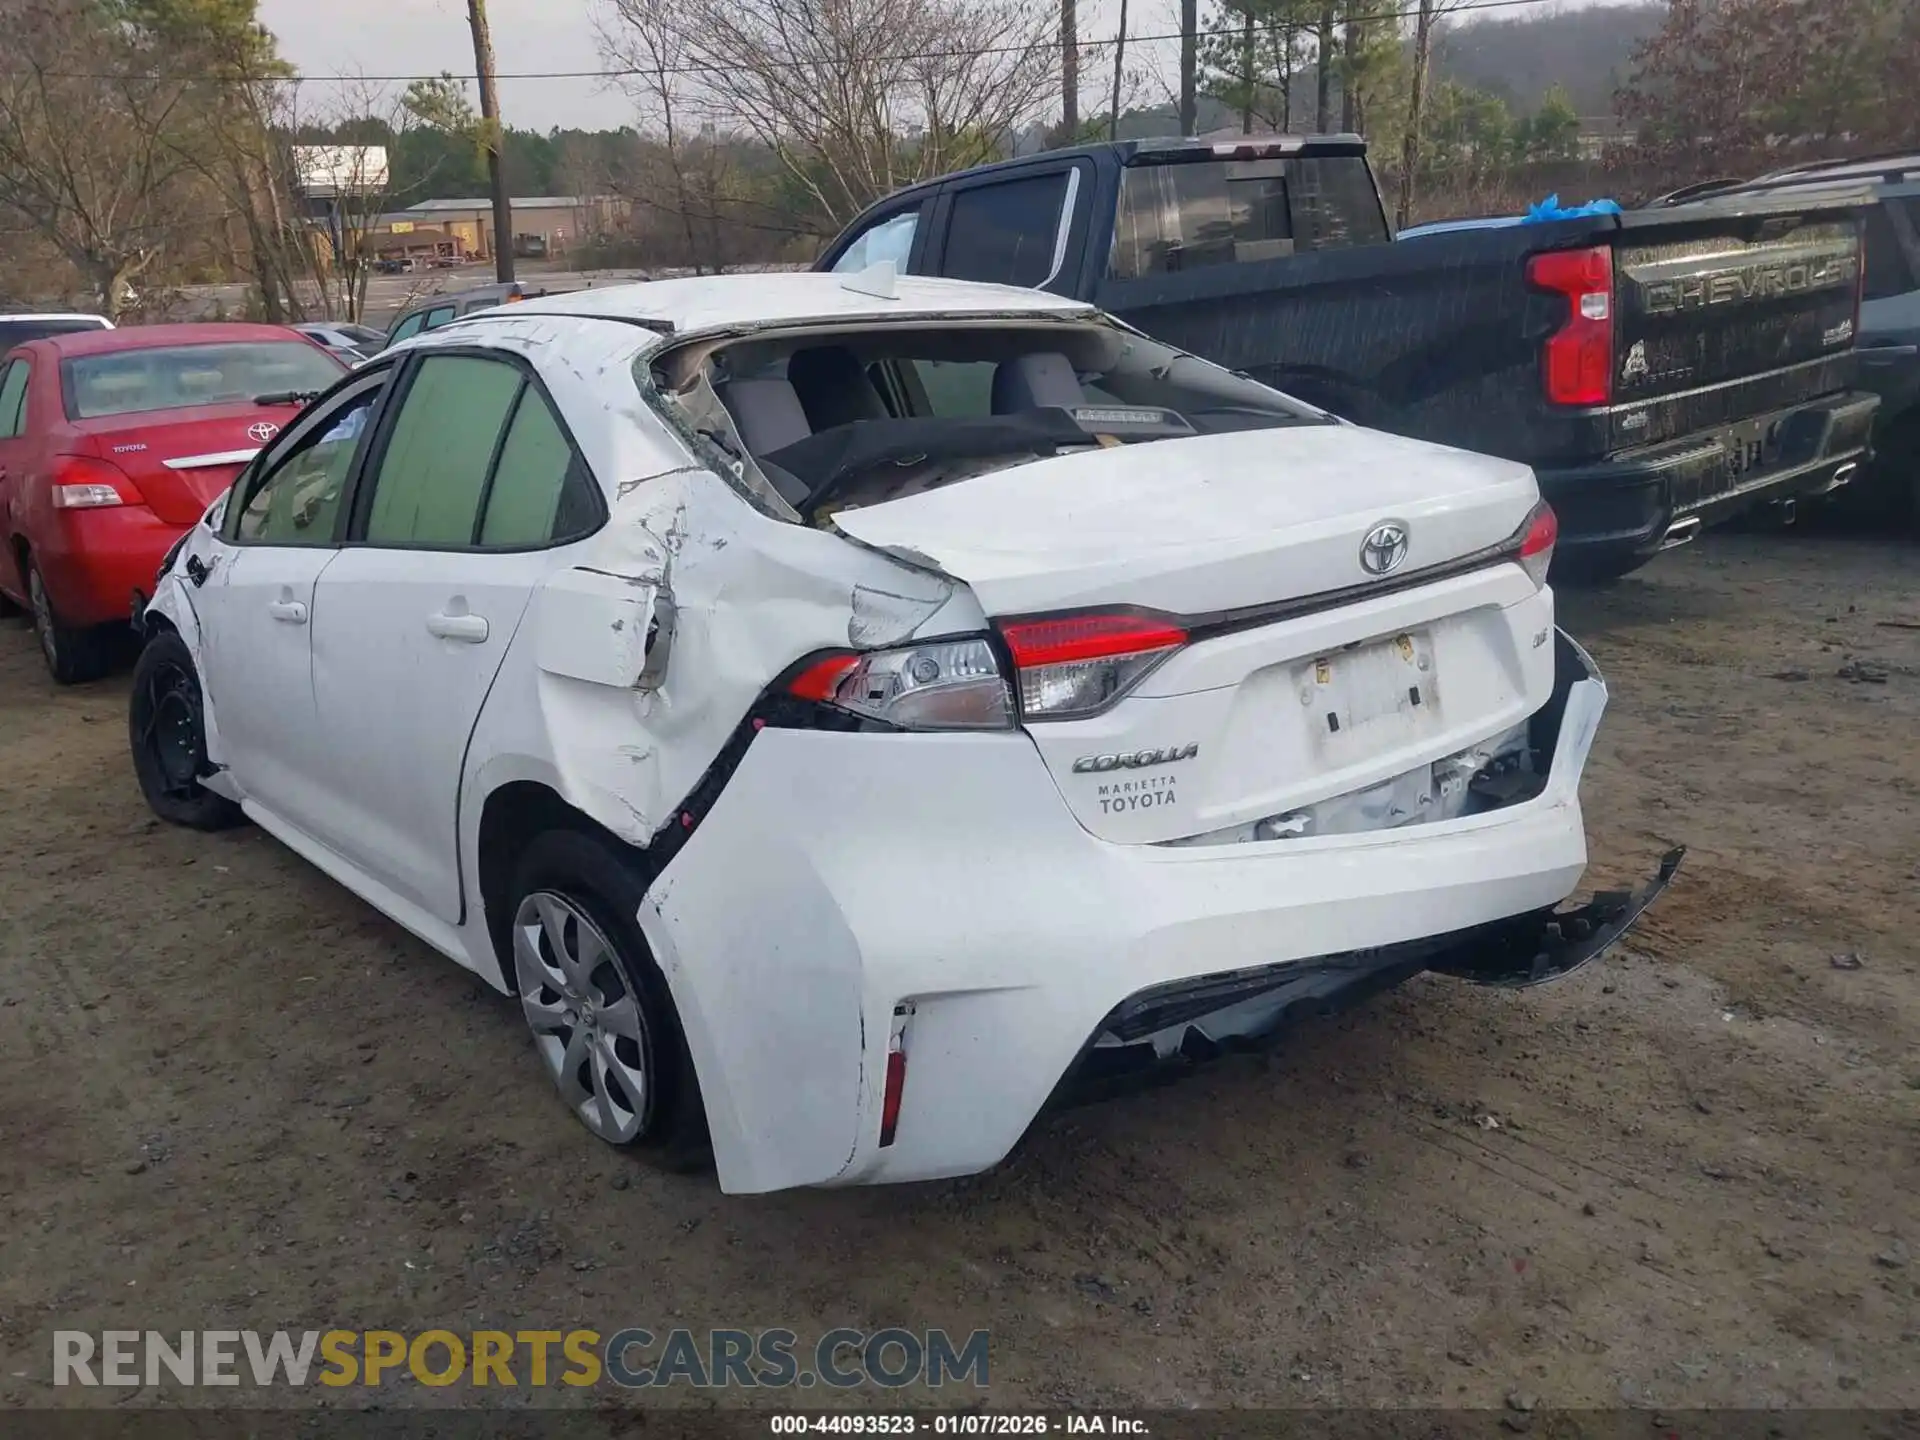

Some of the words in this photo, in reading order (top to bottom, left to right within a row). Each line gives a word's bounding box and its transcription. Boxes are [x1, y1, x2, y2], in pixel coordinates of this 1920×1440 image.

[1641, 256, 1857, 315] CHEVROLET
[112, 443, 147, 453] TOYOTA
[1072, 742, 1199, 773] COROLLA
[1098, 775, 1177, 795] MARIETTA
[1100, 790, 1177, 814] TOYOTA
